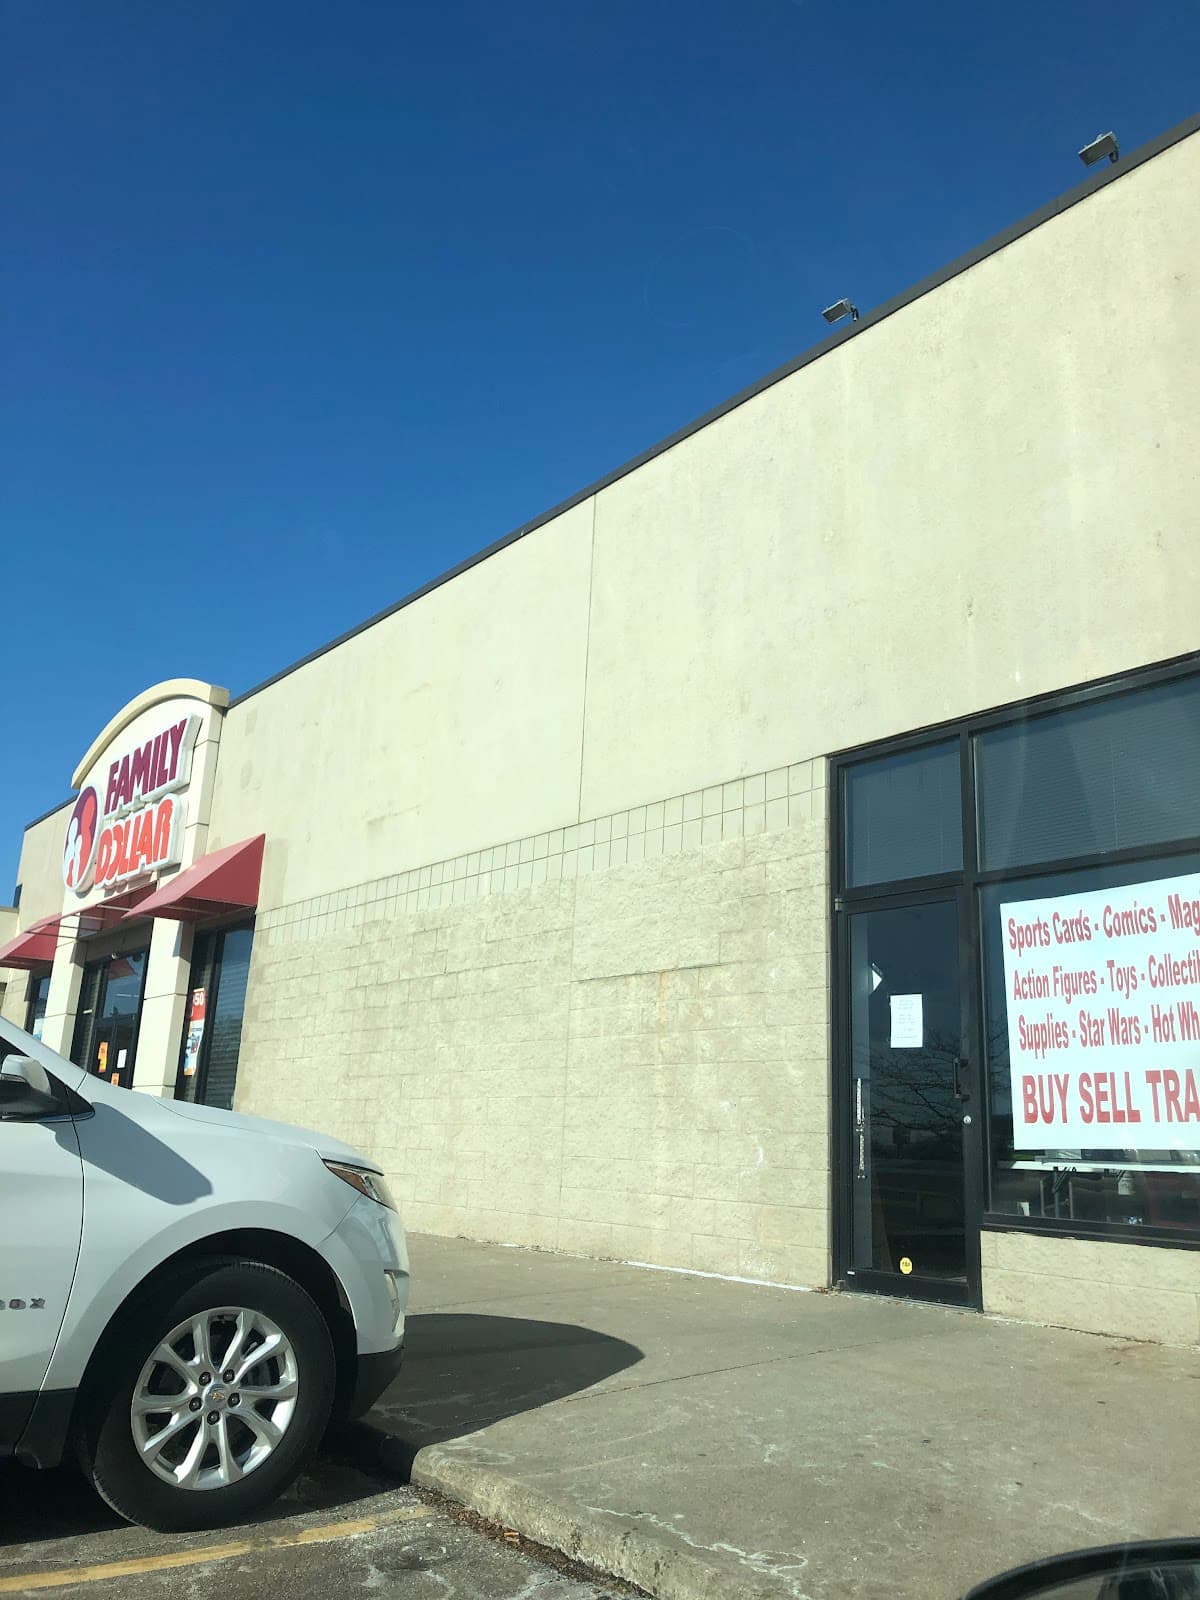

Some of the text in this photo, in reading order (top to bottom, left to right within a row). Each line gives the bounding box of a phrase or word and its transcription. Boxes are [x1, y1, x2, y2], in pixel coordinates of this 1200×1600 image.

[104, 718, 187, 815] FAMILY
[1008, 916, 1050, 957] Sports
[1052, 909, 1092, 944] Cards
[1103, 901, 1157, 938] Comics
[1168, 893, 1200, 936] Mag
[1014, 968, 1050, 1000] Action
[1052, 965, 1097, 1004] Figures
[1107, 959, 1138, 999] Toys
[1018, 1013, 1069, 1059] Supplies
[1079, 1009, 1106, 1047] Star
[1107, 1007, 1141, 1046] Wars
[1151, 1004, 1176, 1042] Hot
[1177, 1001, 1200, 1040] Wh
[1022, 1068, 1200, 1124] BUY SELL TRA
